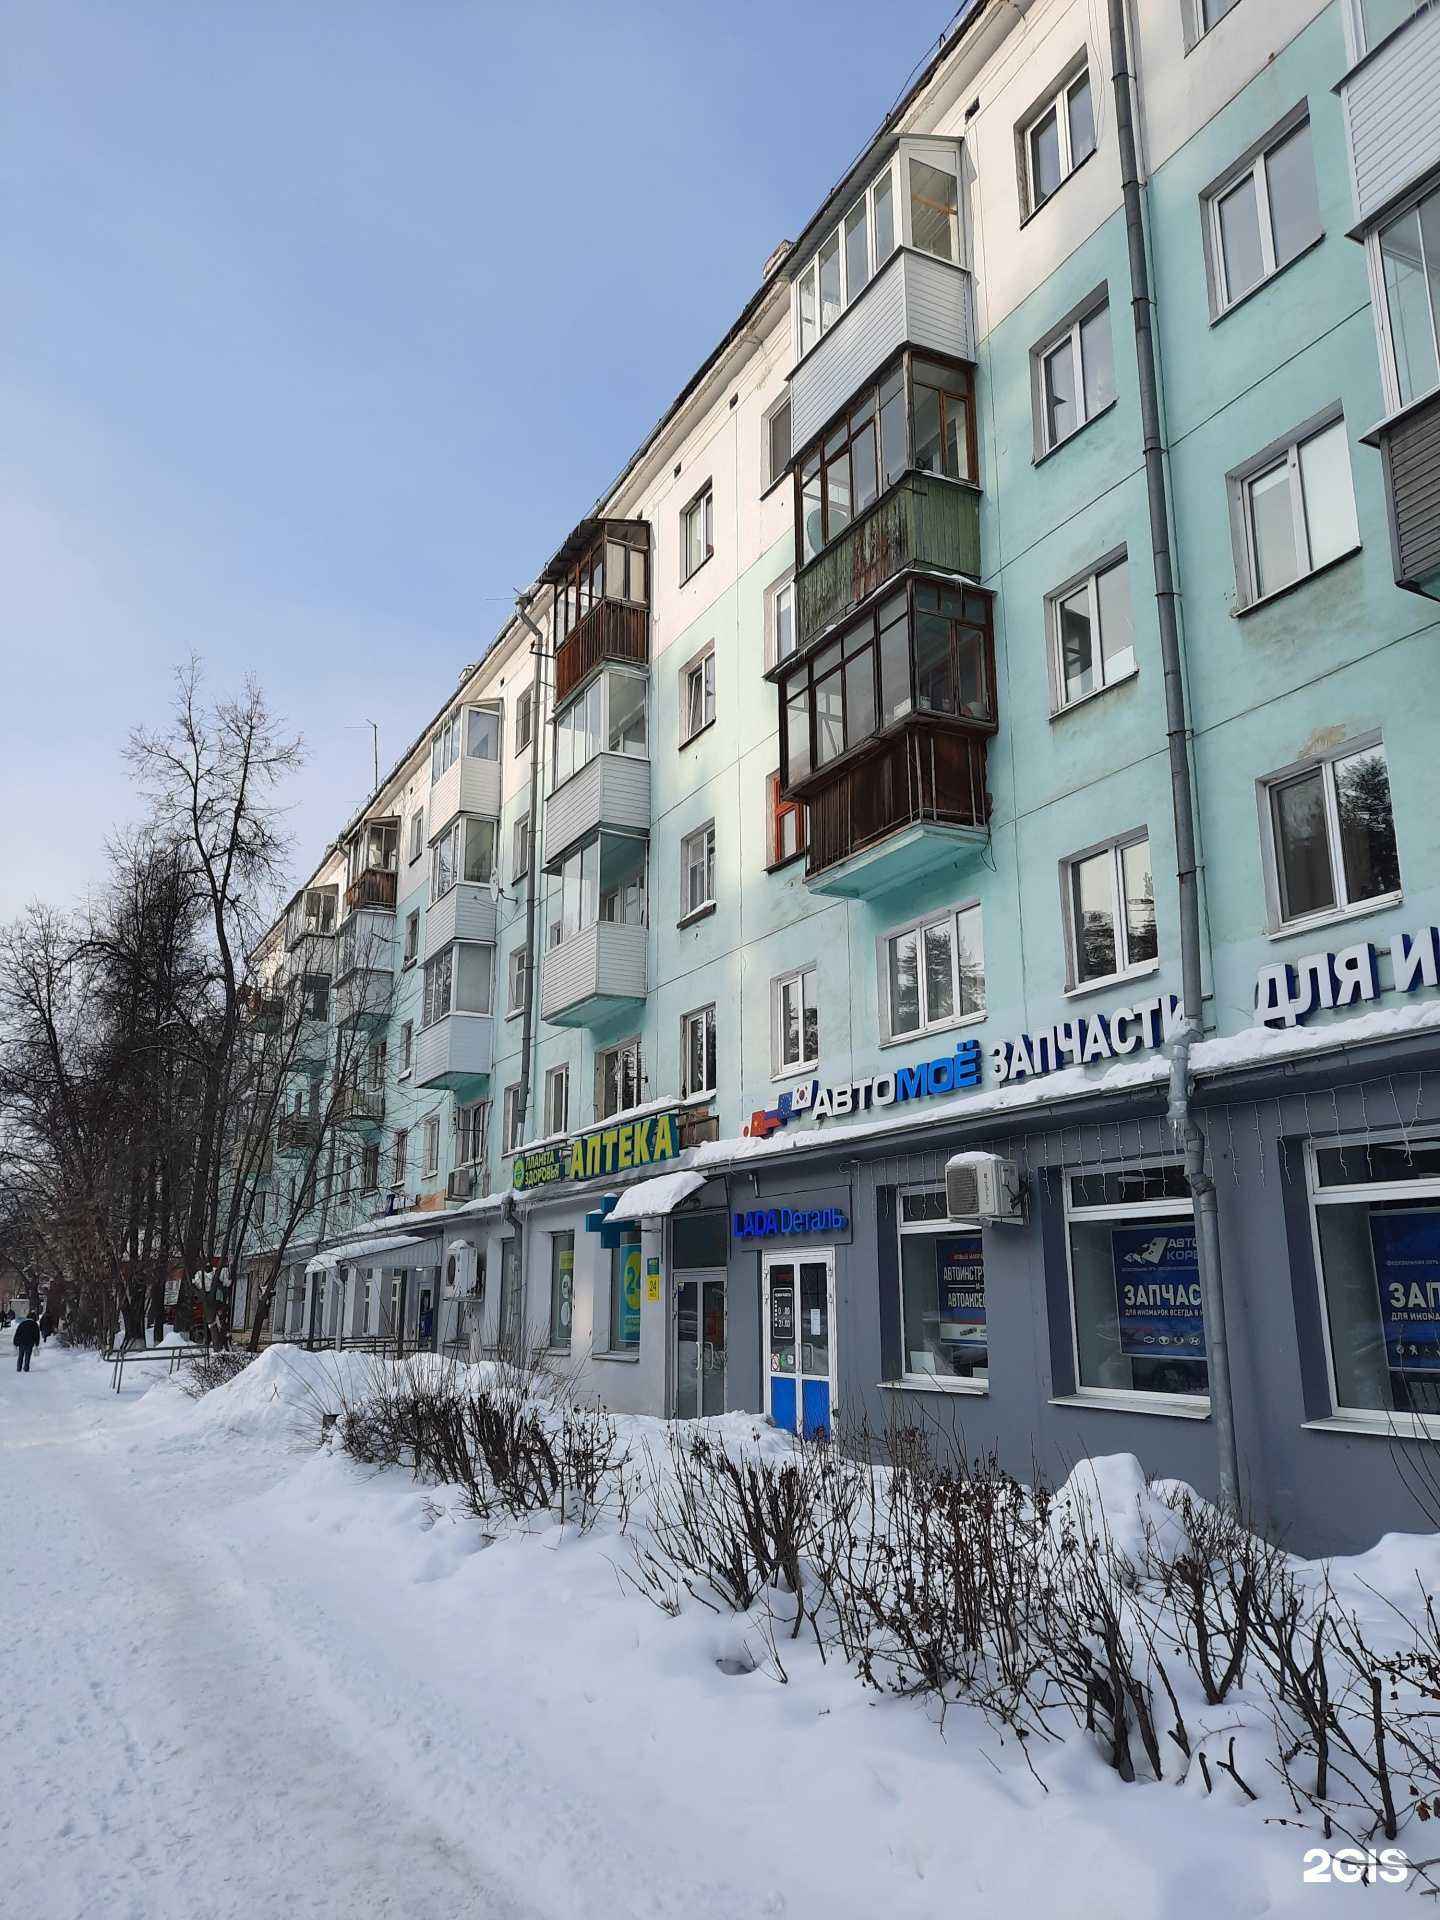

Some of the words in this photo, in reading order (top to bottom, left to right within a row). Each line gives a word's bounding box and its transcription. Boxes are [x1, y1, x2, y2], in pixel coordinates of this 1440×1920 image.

[988, 994, 1184, 1083] ЗАПЧАСТИ
[1254, 942, 1376, 1027] ДЛЯ
[1391, 924, 1440, 992] И
[570, 1114, 674, 1179] АПТЕКА
[525, 1163, 560, 1184] ЗДОРОВЬЯ
[734, 1210, 779, 1237] LADA
[944, 1265, 983, 1281] АВТОИНСТР
[947, 1292, 985, 1308] АВТОАКСЕ
[1389, 1282, 1440, 1308] ЗАП
[1392, 1311, 1408, 1321] ДЛЯ
